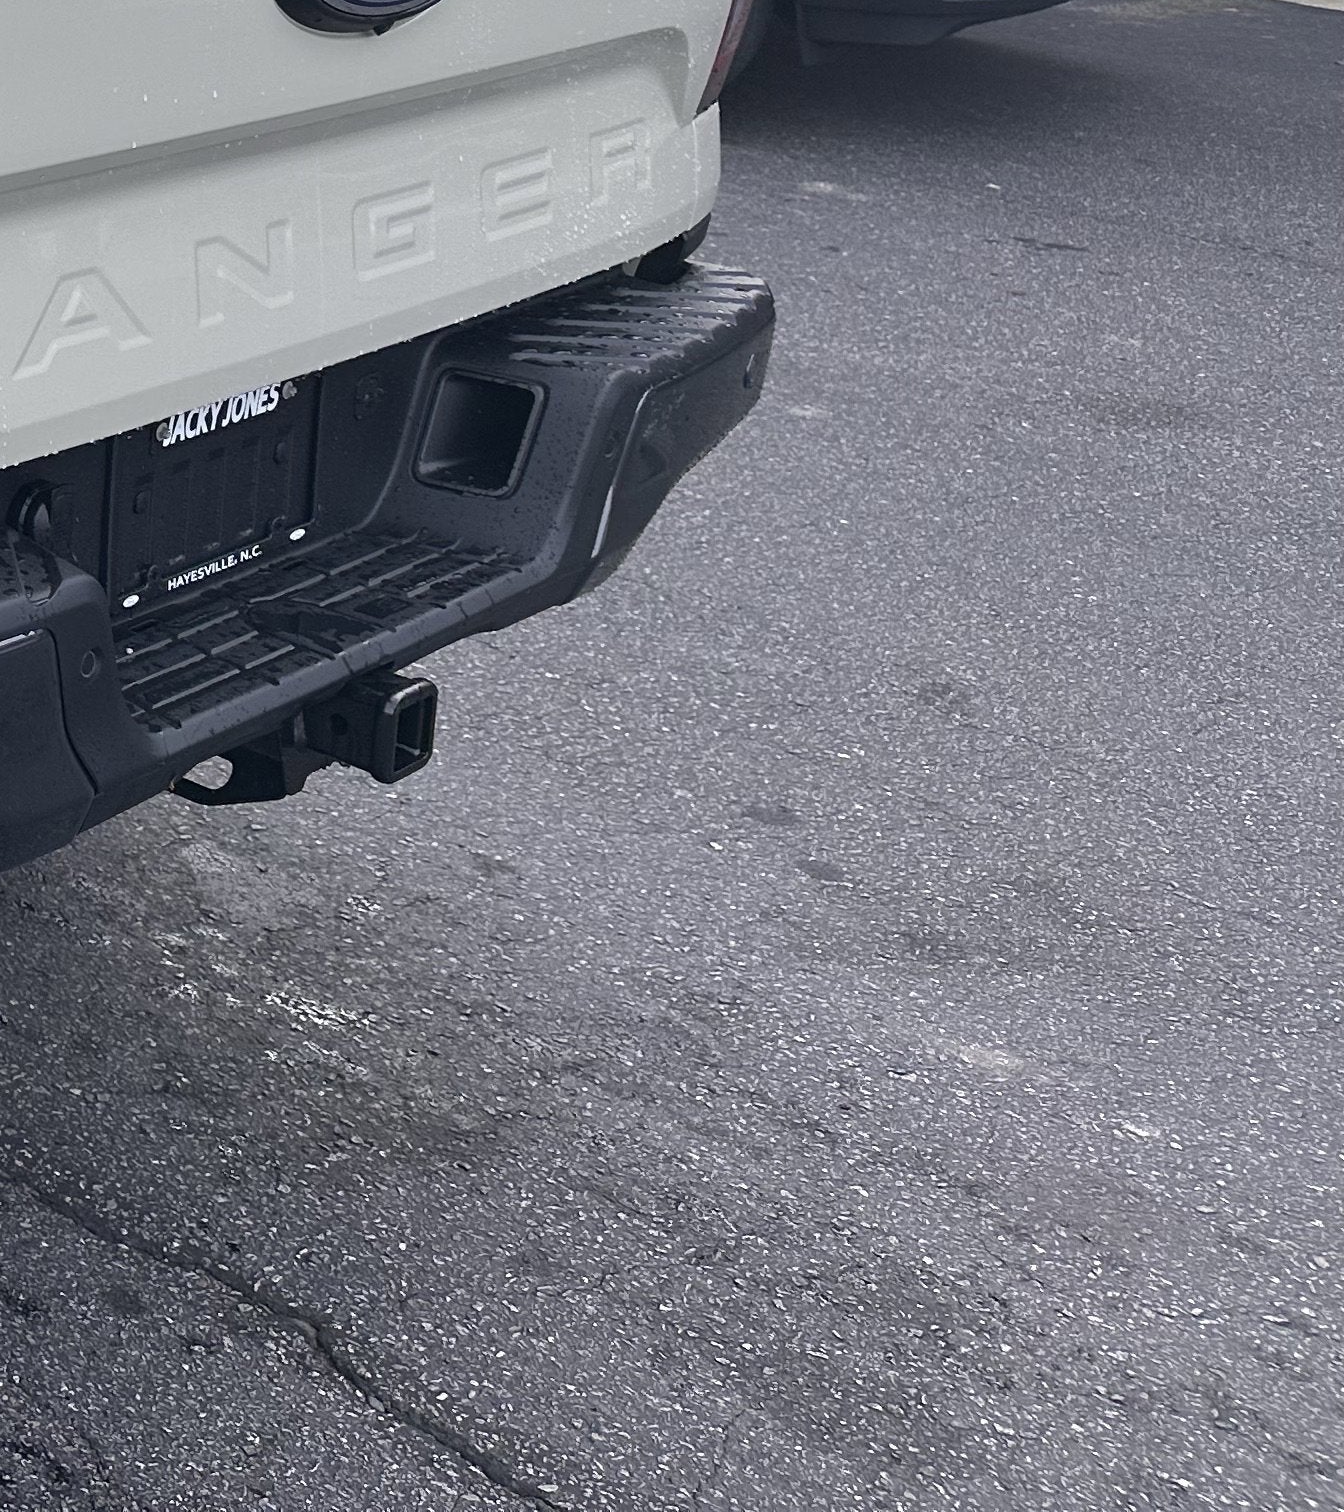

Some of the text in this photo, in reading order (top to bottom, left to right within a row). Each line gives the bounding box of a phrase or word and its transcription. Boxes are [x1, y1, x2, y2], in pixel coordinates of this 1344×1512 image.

[162, 383, 281, 448] JACKY JONES
[167, 544, 262, 590] HAYESVILLE, N.C.
